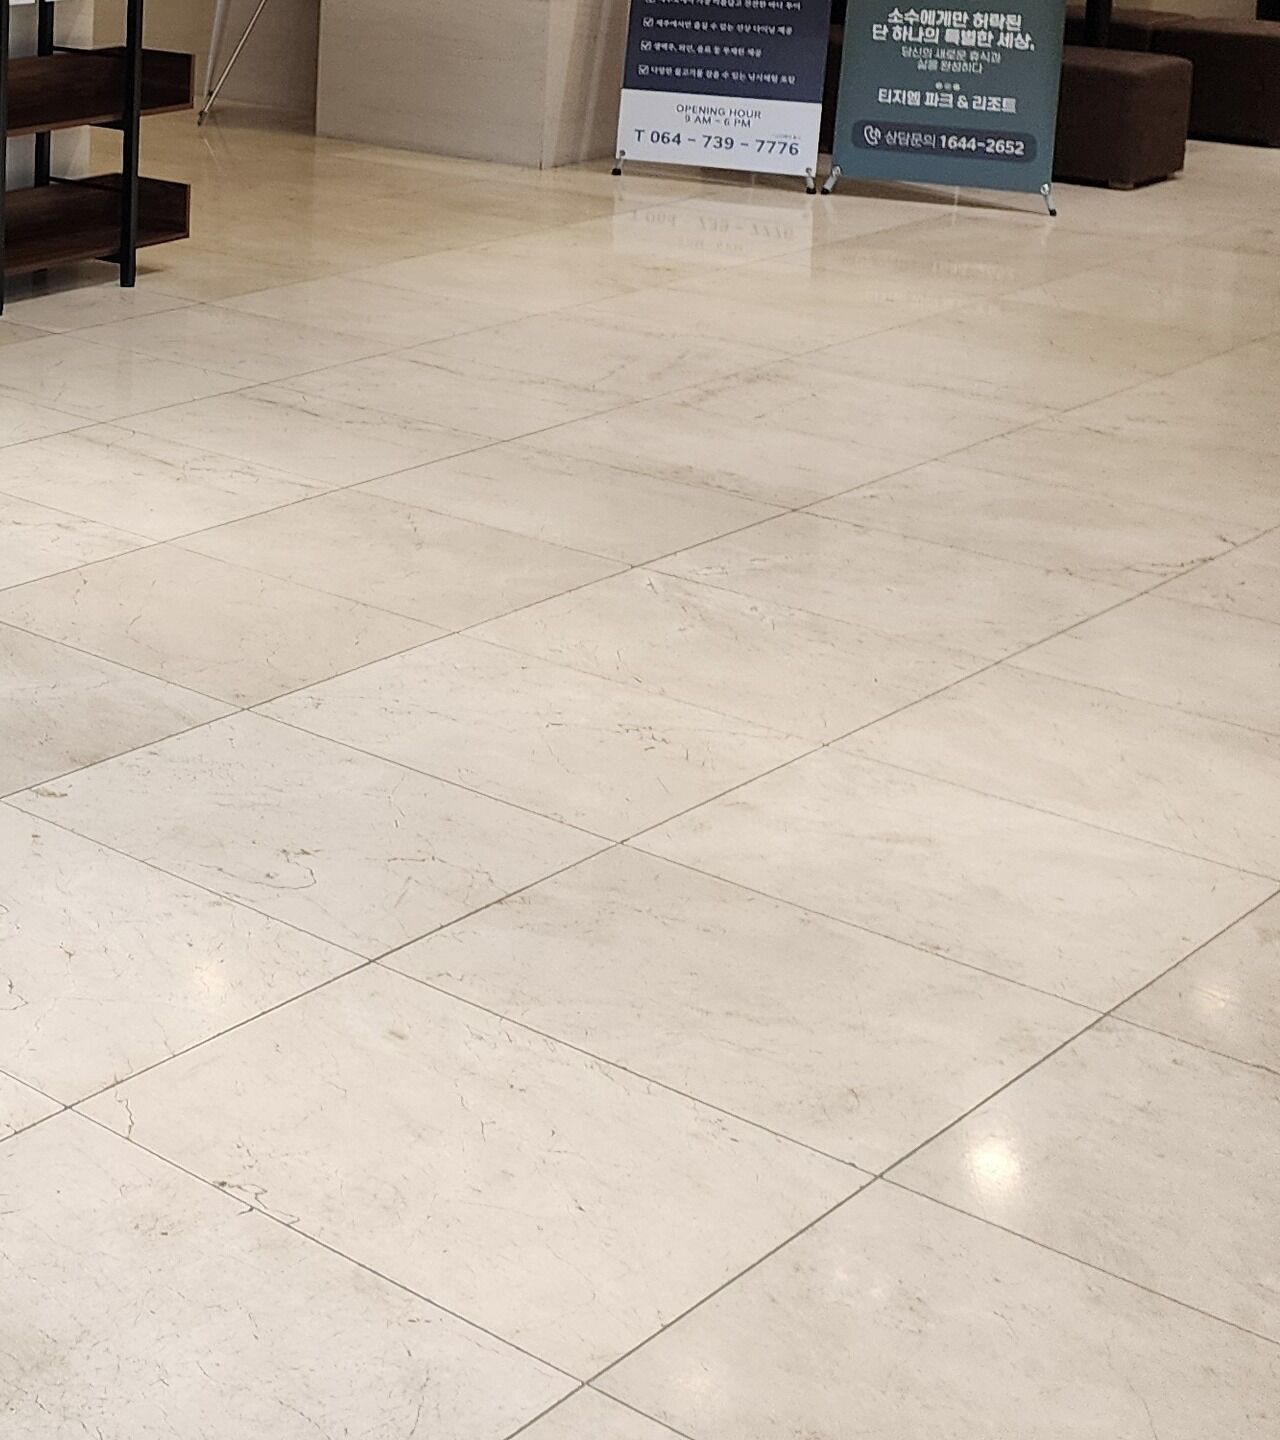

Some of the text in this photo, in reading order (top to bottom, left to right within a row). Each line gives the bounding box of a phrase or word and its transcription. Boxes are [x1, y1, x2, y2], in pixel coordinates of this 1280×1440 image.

[887, 7, 1022, 33] 소수에게만 허락된
[872, 24, 1036, 52] 단 하나의 특별한 세상.
[676, 103, 762, 120] OPENING HOUR
[878, 87, 1017, 114] 티지엠 파크 & 리조트
[694, 115, 712, 125] AM
[733, 119, 751, 128] PM
[634, 129, 646, 143] T
[650, 130, 682, 145] 064
[702, 134, 735, 150] 739
[755, 139, 800, 156] 7776
[884, 130, 1025, 156] 상담문의 1644-2652
